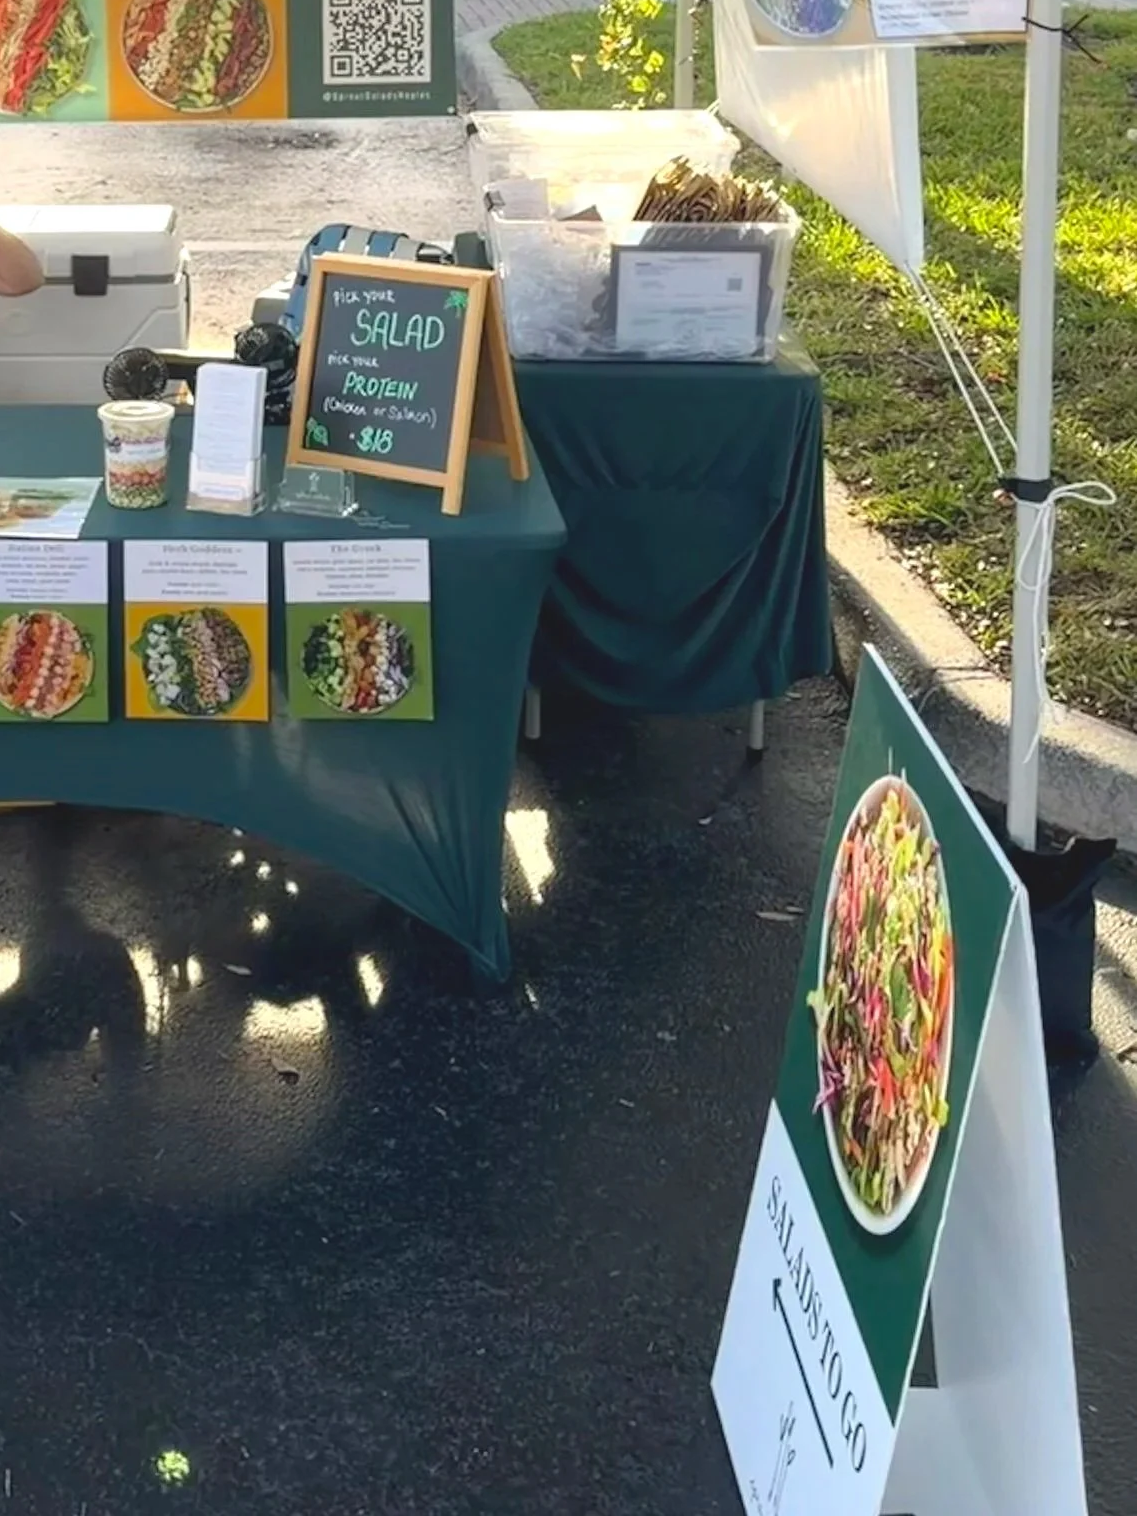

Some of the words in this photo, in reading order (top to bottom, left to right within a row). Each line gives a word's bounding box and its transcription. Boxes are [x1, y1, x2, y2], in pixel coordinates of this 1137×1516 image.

[349, 308, 446, 353] SALAD
[342, 370, 419, 401] PROTEIN
[767, 1174, 823, 1341] SALADS
[819, 1319, 843, 1401] TO
[840, 1389, 867, 1474] GO
